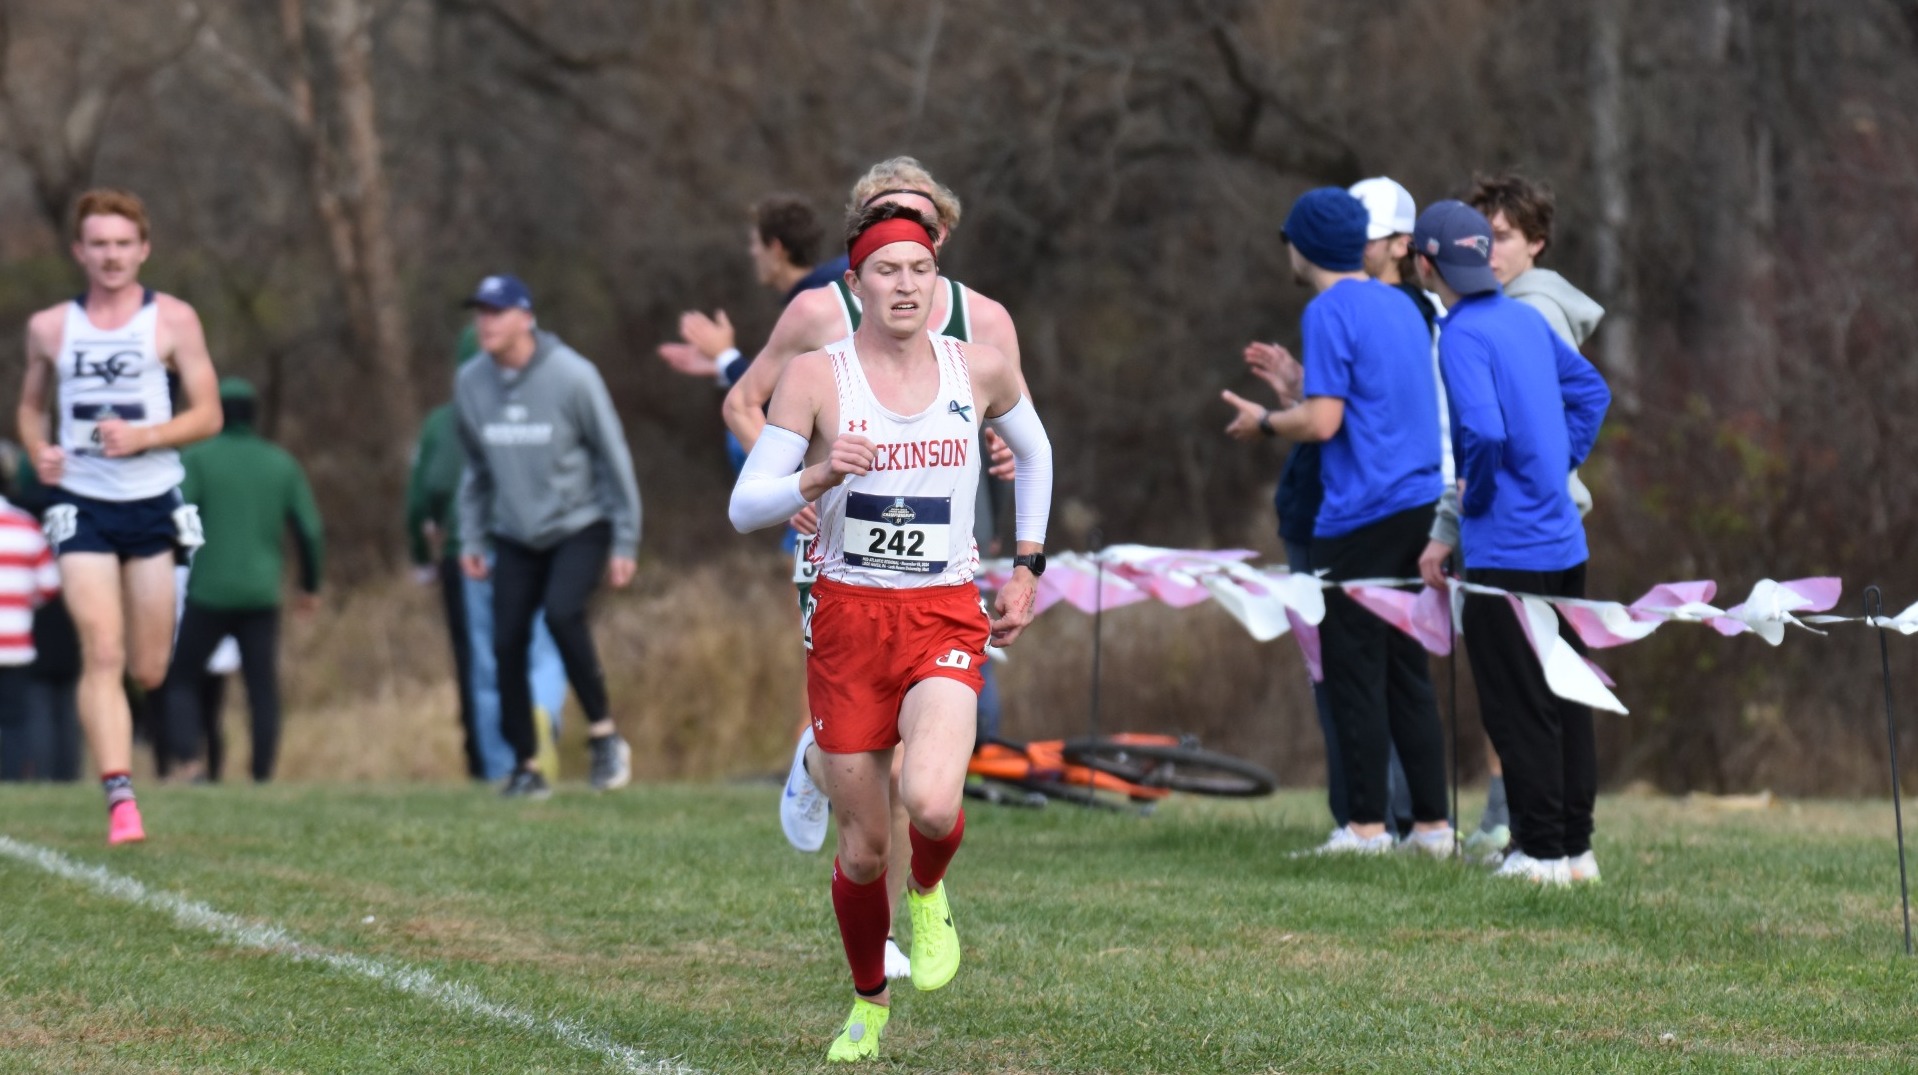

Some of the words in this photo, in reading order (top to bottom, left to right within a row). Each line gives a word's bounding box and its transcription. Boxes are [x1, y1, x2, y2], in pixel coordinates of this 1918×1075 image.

[74, 351, 143, 385] LVC
[867, 438, 968, 472] CKINSON
[869, 528, 925, 556] 242
